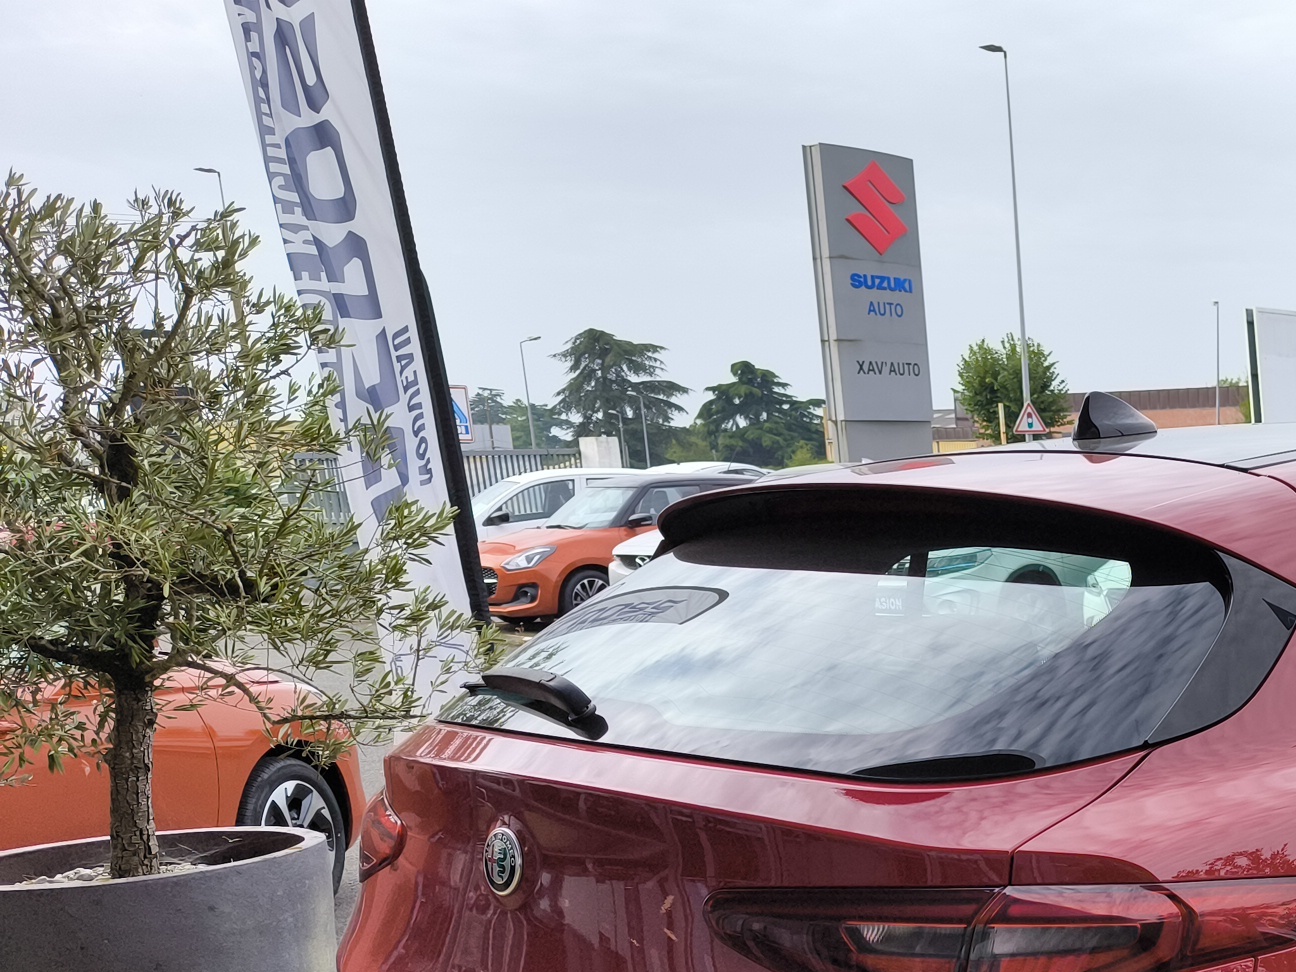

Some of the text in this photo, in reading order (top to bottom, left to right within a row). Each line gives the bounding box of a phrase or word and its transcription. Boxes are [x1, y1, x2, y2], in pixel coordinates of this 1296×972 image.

[850, 273, 913, 294] SUZUKI
[867, 301, 904, 318] AUTO
[856, 360, 921, 377] XAV'AUTO
